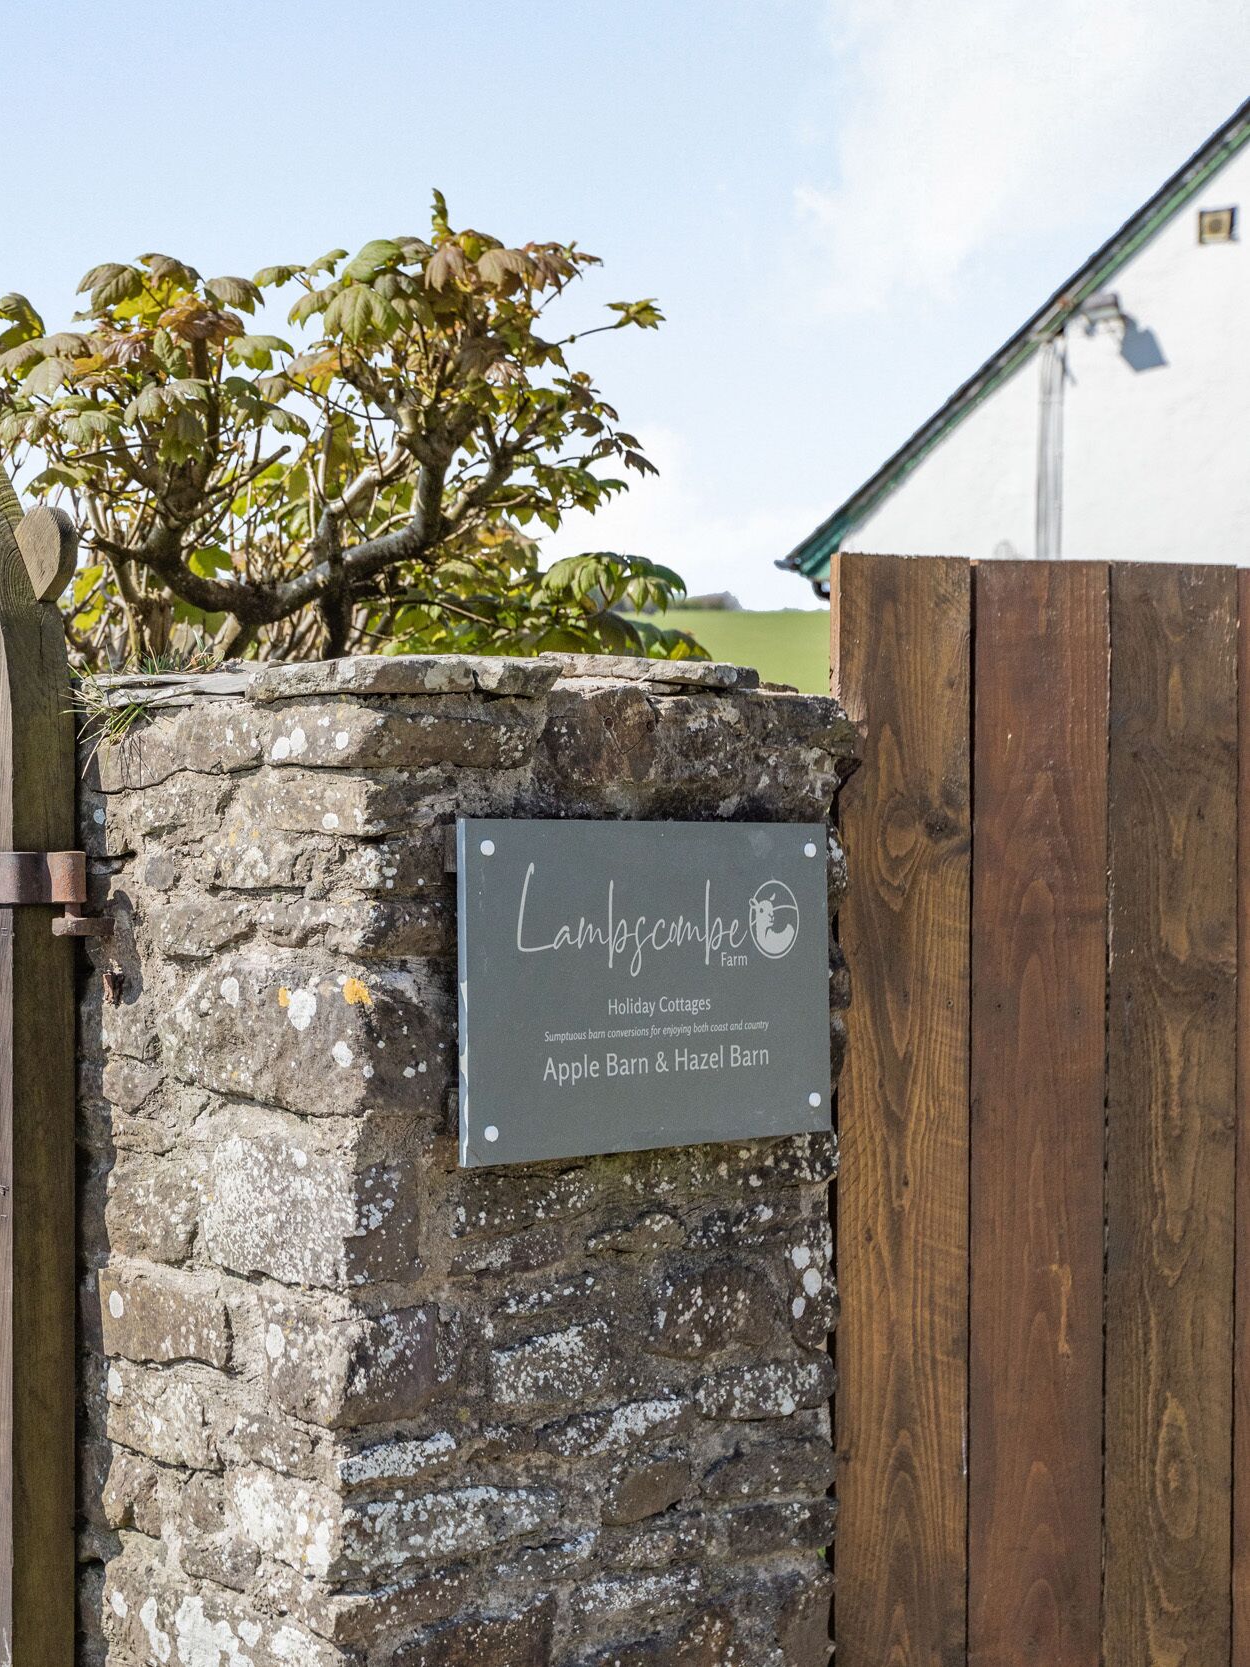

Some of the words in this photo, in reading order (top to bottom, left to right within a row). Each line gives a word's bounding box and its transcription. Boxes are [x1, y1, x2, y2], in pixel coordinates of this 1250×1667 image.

[517, 862, 748, 977] Lambscombe
[721, 952, 748, 966] Farm
[608, 997, 655, 1017] Holiday
[659, 996, 711, 1015] Cottages
[544, 1031, 587, 1044] Sumptuous
[588, 1029, 606, 1039] barn
[607, 1026, 649, 1038] conversions
[649, 1025, 661, 1038] for
[663, 1023, 692, 1037] enjoying
[693, 1022, 709, 1033] both
[710, 1022, 729, 1032] coast
[730, 1020, 743, 1031] and
[744, 1020, 769, 1031] country
[543, 1054, 600, 1086] Apple
[606, 1053, 649, 1076] Barn
[655, 1051, 669, 1073] &
[675, 1045, 724, 1072] Hazel
[730, 1044, 770, 1068] Barn
